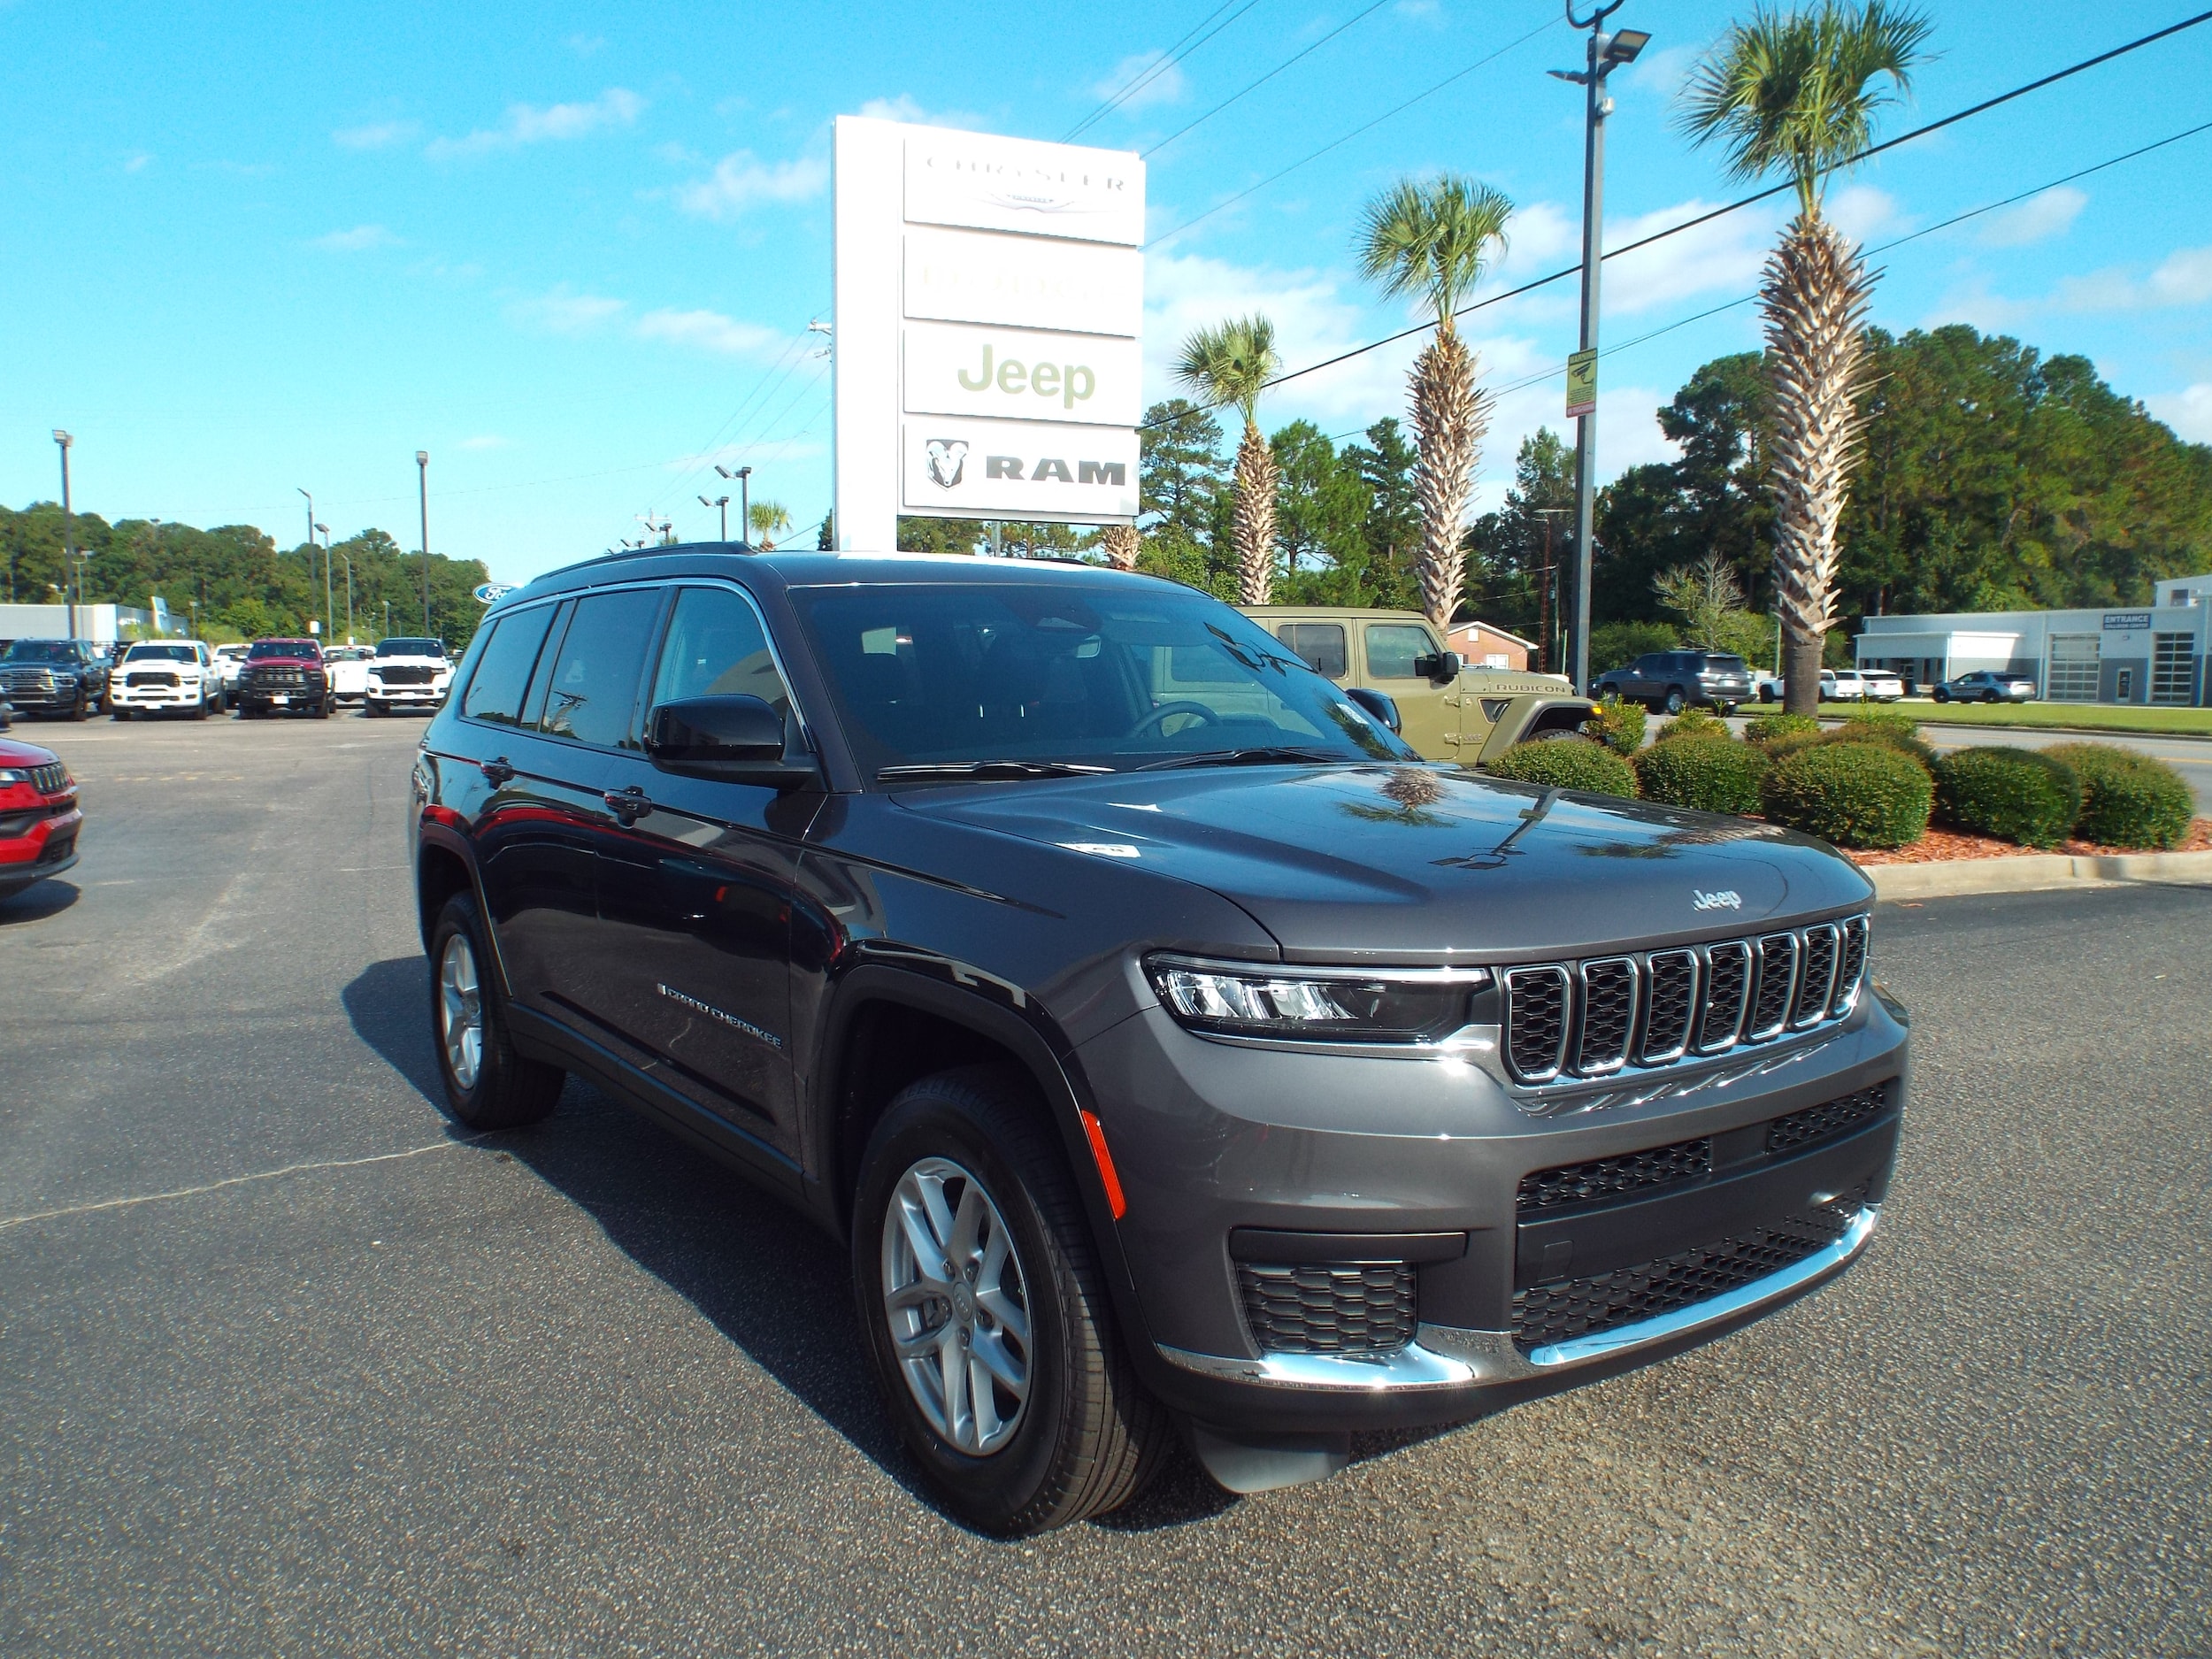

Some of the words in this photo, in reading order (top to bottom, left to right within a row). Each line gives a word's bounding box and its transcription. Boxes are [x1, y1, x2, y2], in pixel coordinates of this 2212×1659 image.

[957, 344, 1095, 409] Jeep
[986, 455, 1125, 487] RAM
[1496, 684, 1565, 693] RUBICON
[1692, 889, 1742, 911] Jeep
[667, 988, 710, 1013] GRAND
[711, 1008, 782, 1048] CHEROKEE
